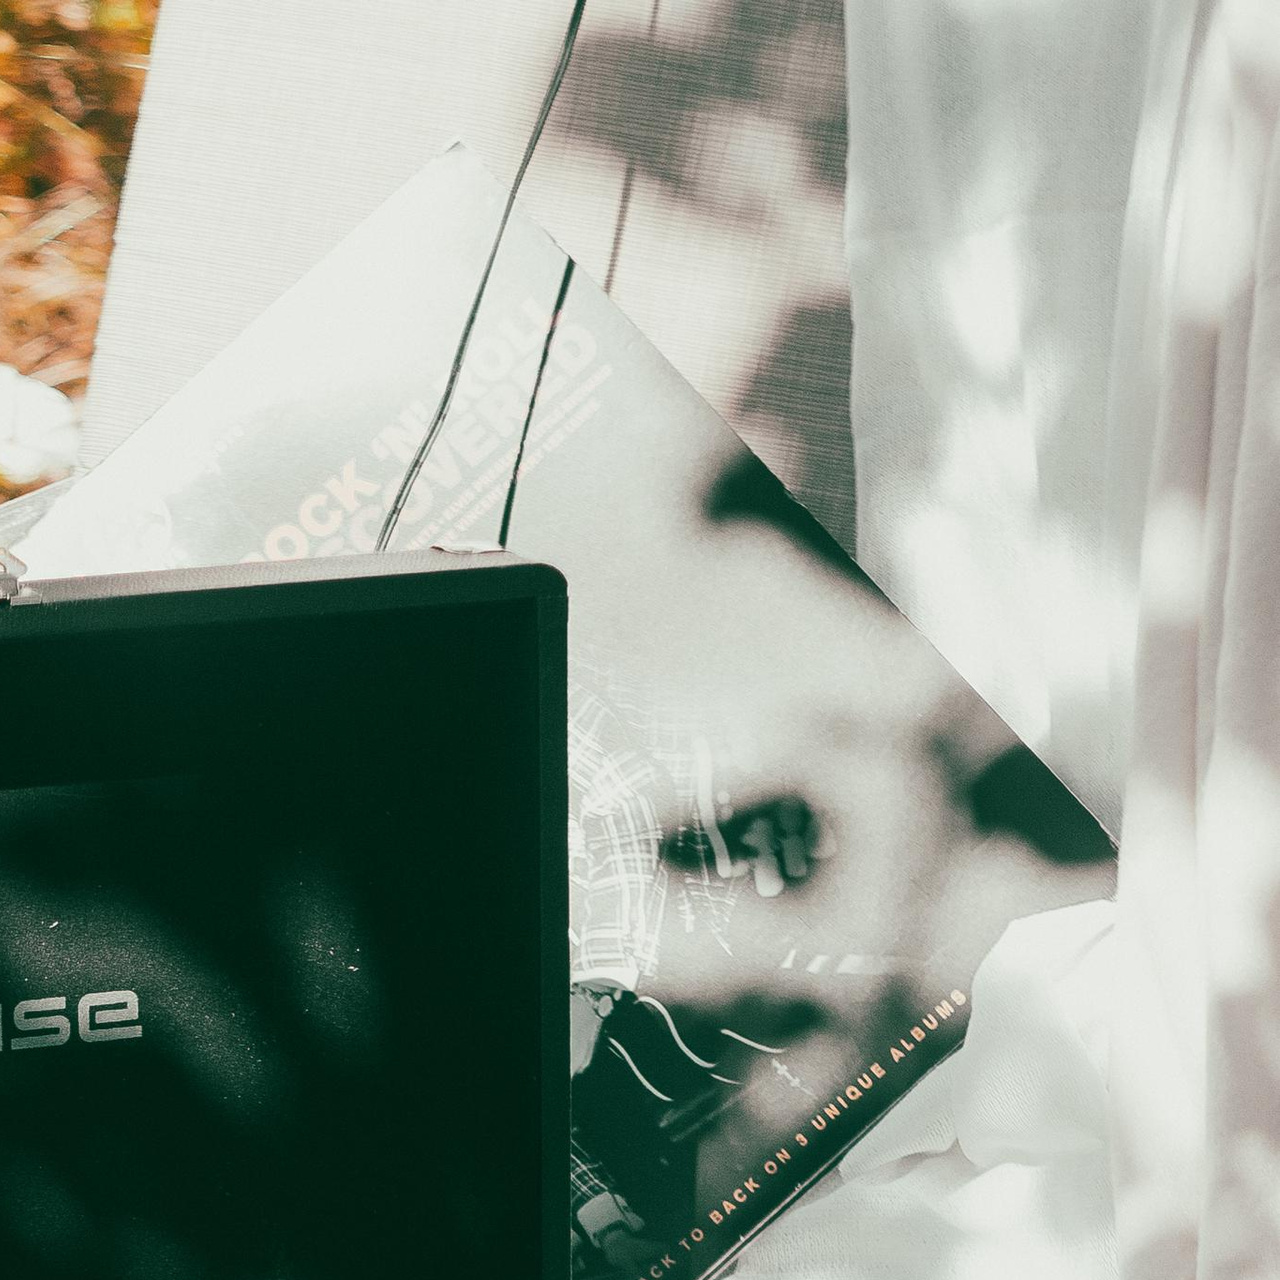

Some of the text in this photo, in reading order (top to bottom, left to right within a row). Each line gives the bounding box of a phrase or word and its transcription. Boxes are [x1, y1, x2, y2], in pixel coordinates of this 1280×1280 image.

[239, 457, 382, 562] OCK
[678, 1228, 705, 1251] TO
[709, 1177, 761, 1225] BACK
[764, 1148, 792, 1175] ON
[811, 1062, 887, 1131] UNIQUE
[889, 989, 967, 1063] ALBUMS
